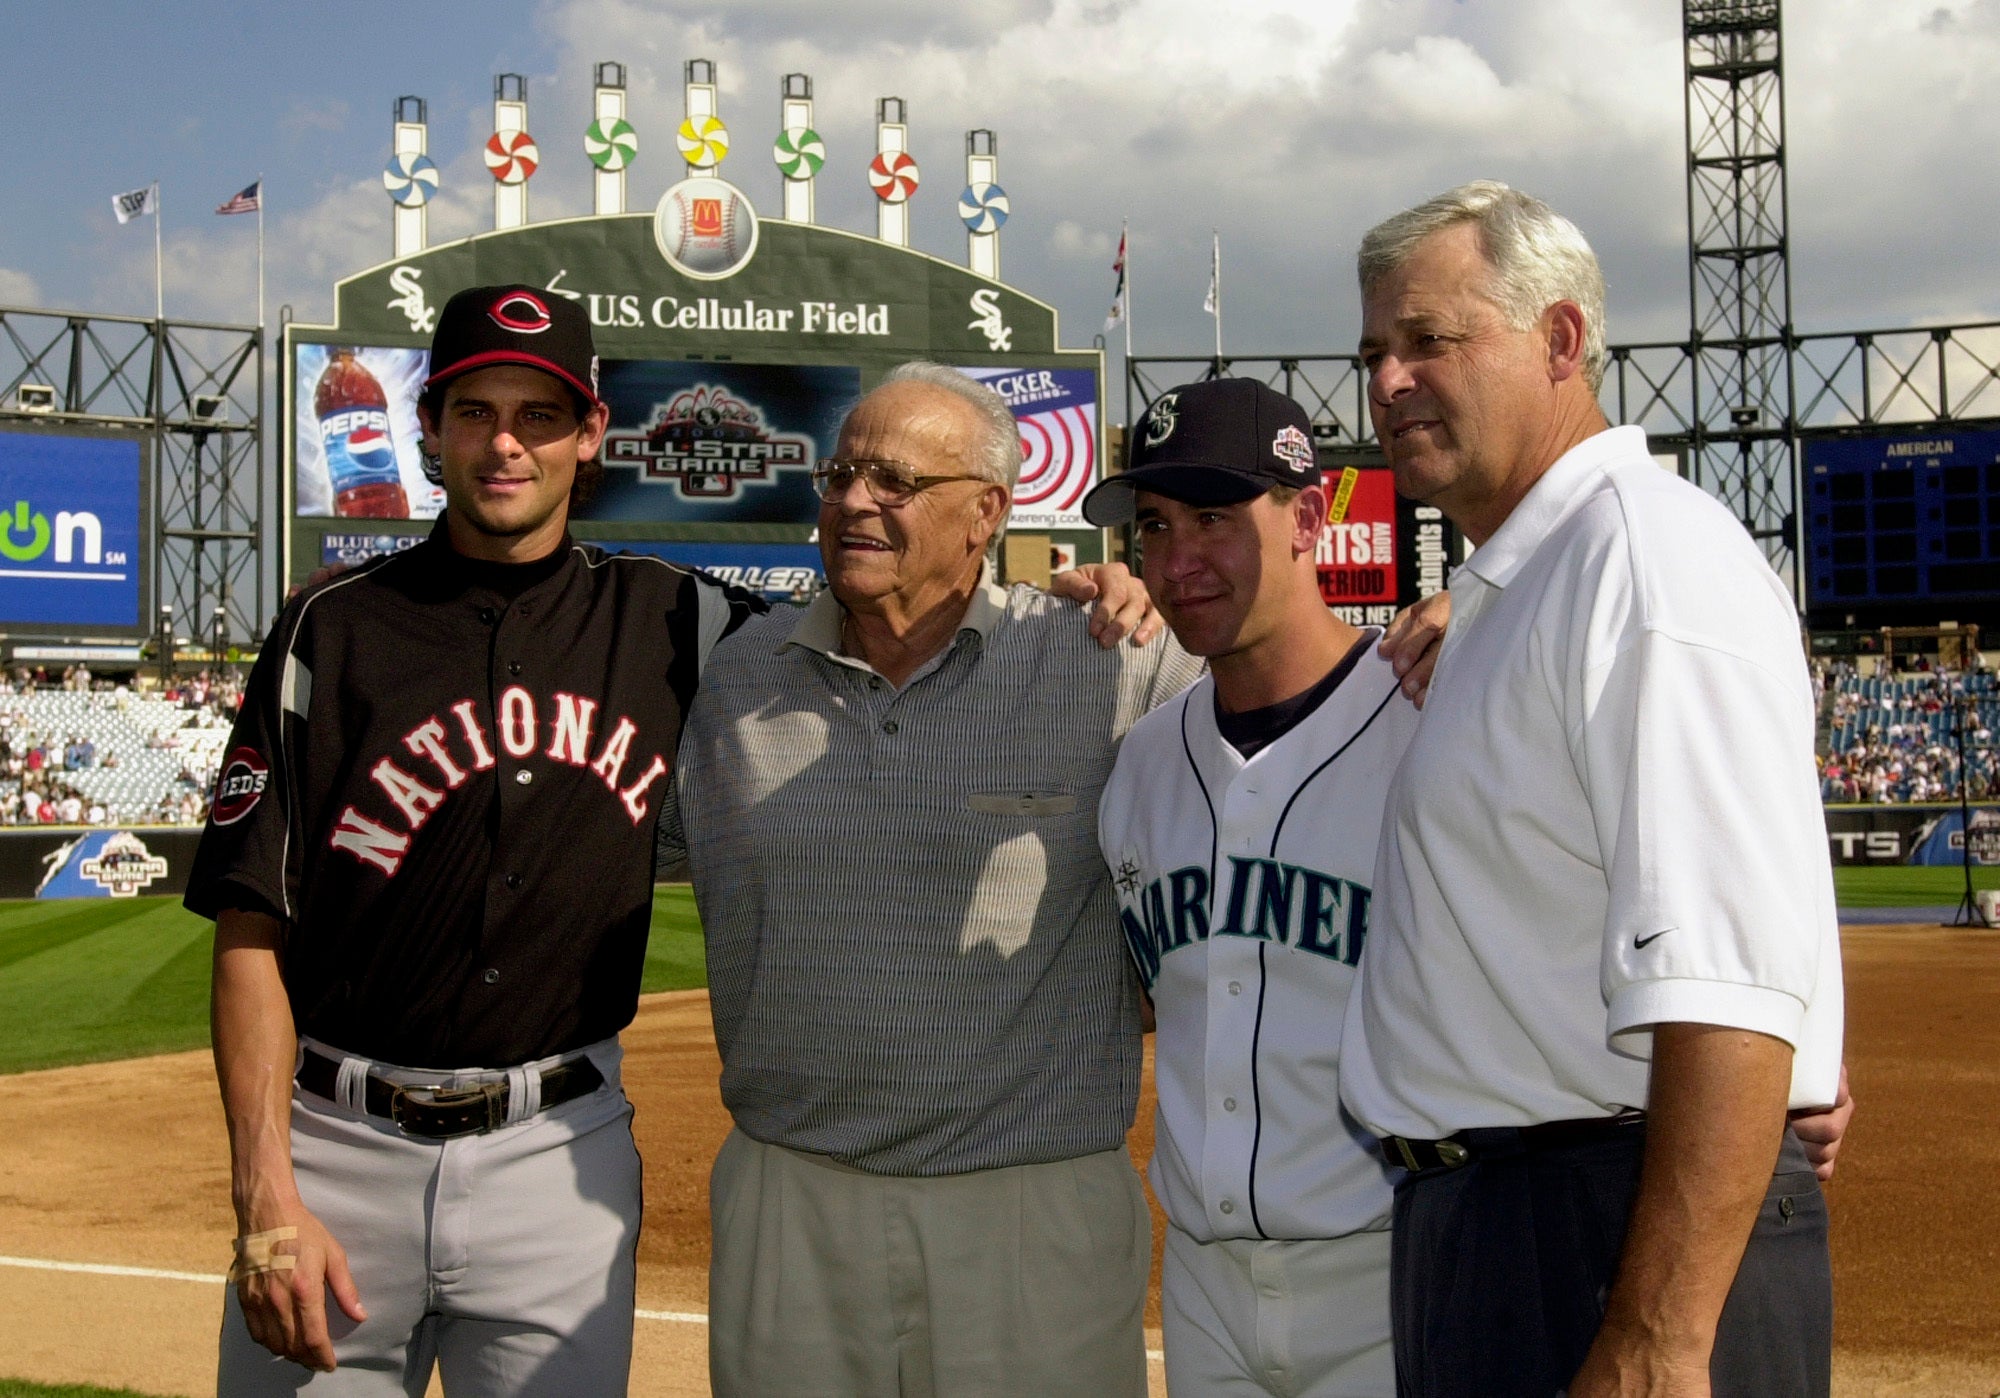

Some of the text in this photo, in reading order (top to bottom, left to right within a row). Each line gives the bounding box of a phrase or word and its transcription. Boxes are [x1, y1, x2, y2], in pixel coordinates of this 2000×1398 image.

[588, 293, 891, 336] U.S. Cellular Field
[320, 410, 390, 438] PEPSI
[1886, 440, 1954, 458] AMERICAN
[655, 458, 763, 474] GAME
[326, 535, 375, 550] BLUE
[1371, 521, 1393, 565] SHOW
[105, 551, 127, 566] SM
[1366, 604, 1398, 625] NET
[329, 684, 667, 877] NATIONAL
